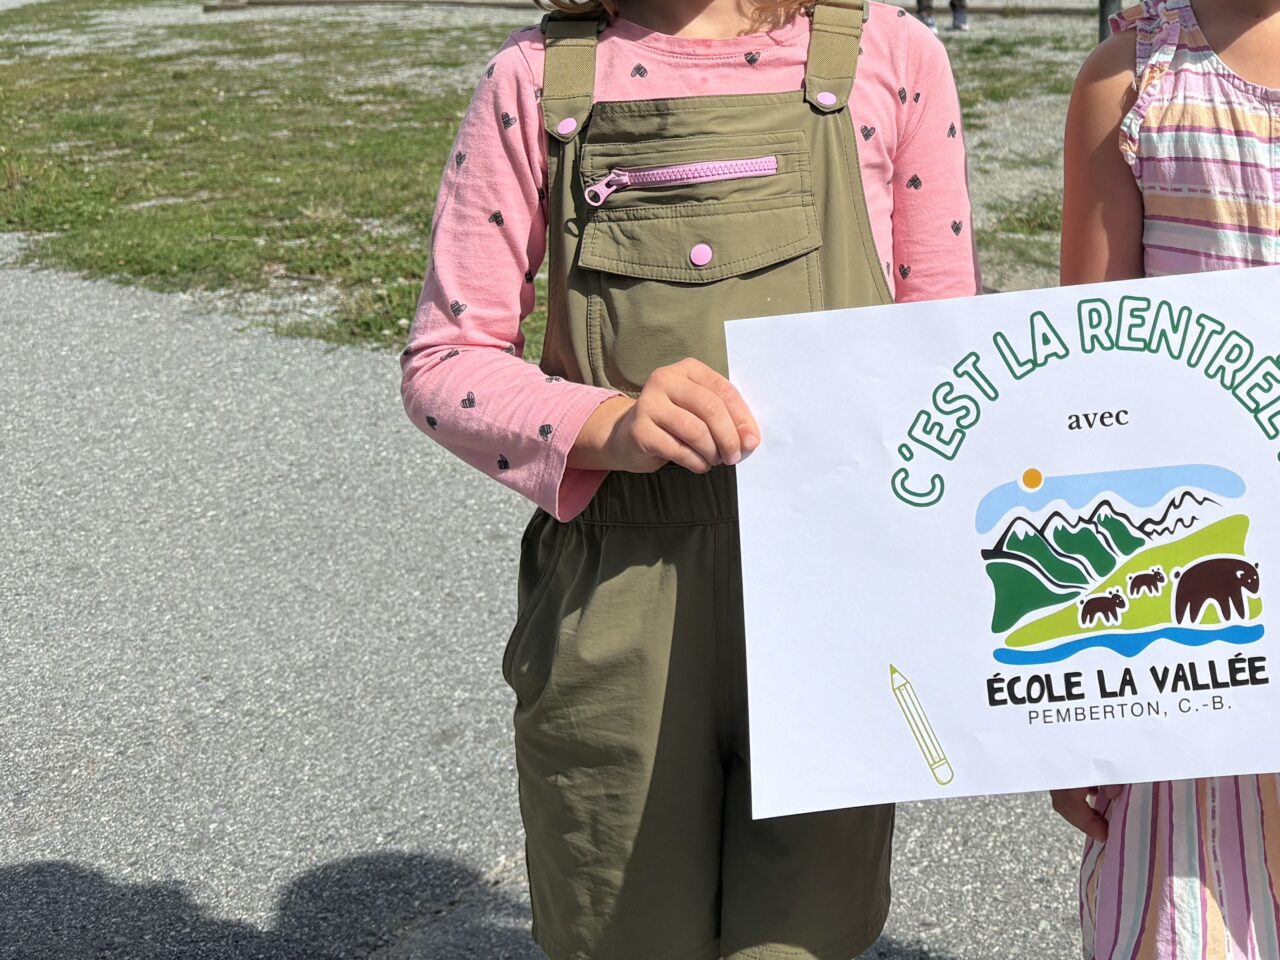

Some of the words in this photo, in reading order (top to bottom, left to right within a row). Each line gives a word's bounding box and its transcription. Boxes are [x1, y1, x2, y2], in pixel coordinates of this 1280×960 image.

[891, 351, 999, 507] C'EST
[992, 310, 1070, 380] LA
[1067, 409, 1130, 431] avec
[986, 672, 1086, 707] ÉCOLE
[1097, 667, 1138, 699] LA
[1149, 652, 1270, 695] VALLÉE
[1028, 700, 1168, 725] PEMBERTON,
[1178, 696, 1232, 714] C.-B.
